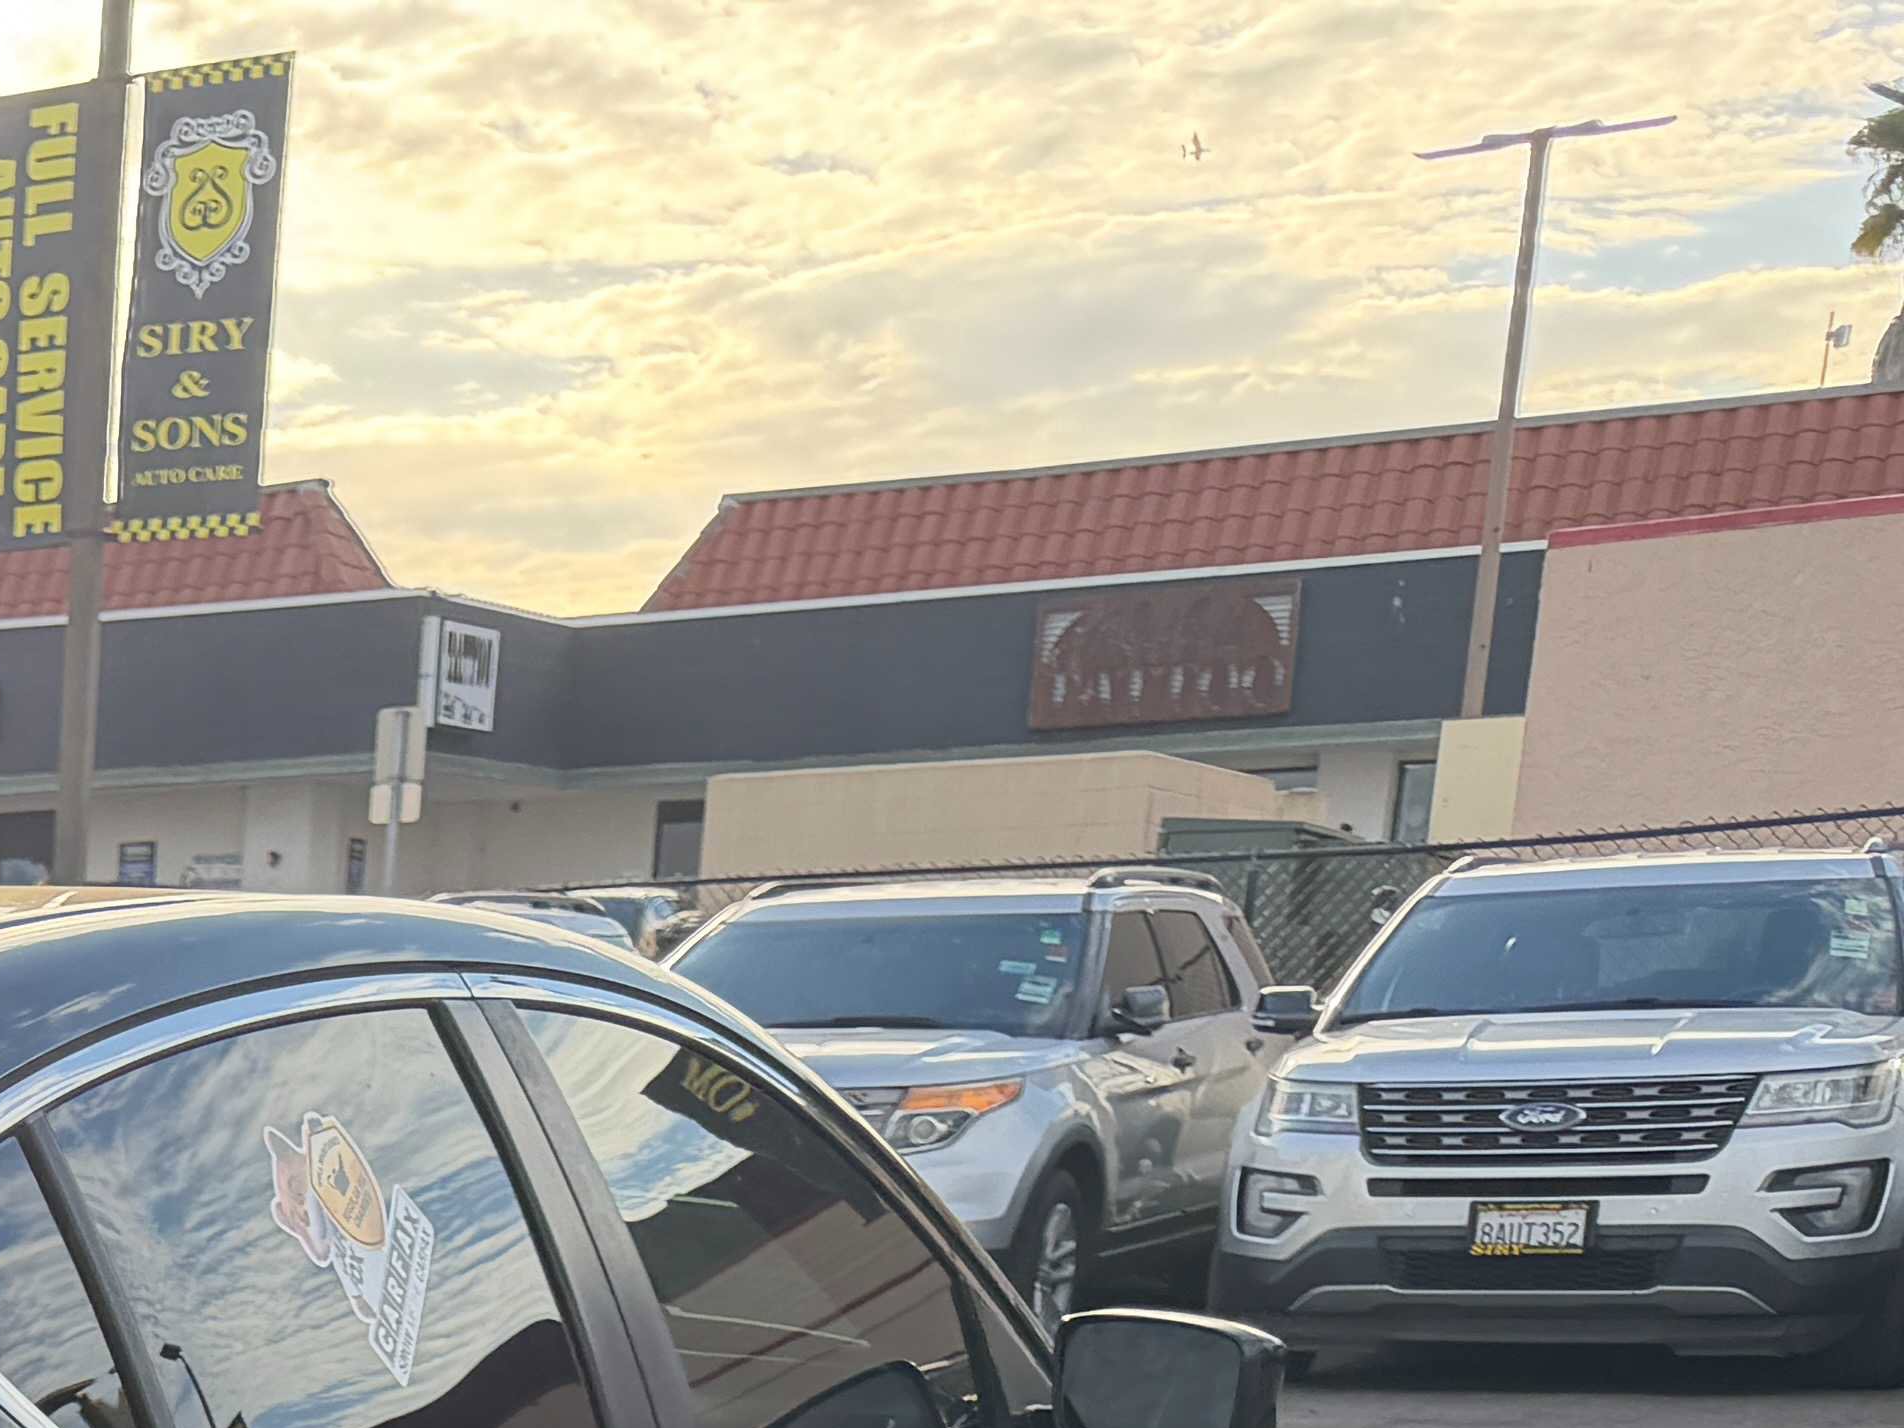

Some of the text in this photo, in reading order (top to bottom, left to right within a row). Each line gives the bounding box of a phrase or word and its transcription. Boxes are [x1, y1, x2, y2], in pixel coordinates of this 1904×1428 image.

[12, 102, 80, 538] FULL SERVICE
[136, 317, 255, 358] SIRY
[171, 370, 210, 400] &
[130, 414, 249, 453] SONS
[376, 1205, 423, 1354] CARFAX
